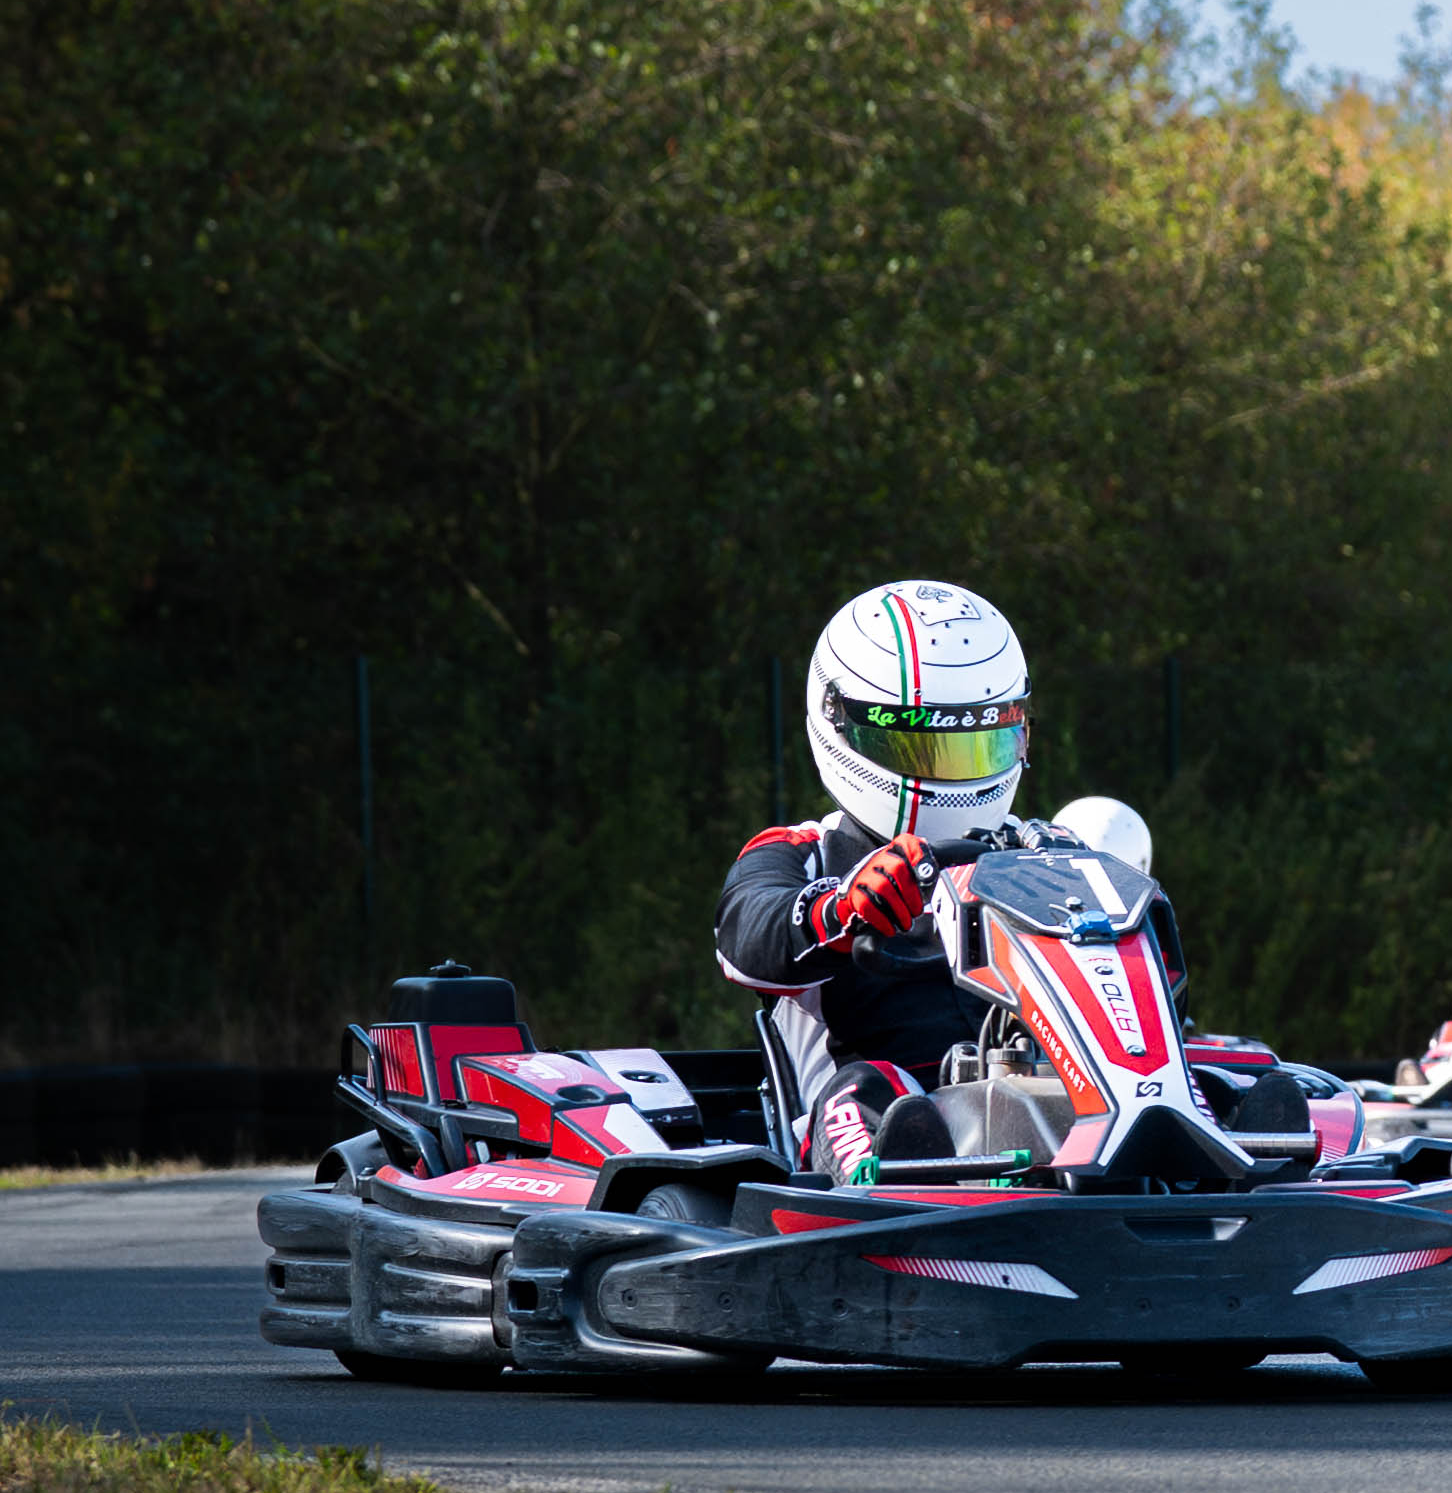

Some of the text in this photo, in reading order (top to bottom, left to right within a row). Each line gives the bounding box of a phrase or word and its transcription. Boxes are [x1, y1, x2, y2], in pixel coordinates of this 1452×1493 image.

[867, 706, 896, 726] La
[901, 707, 958, 727] Vita
[961, 712, 976, 726] è
[1069, 858, 1128, 914] 1
[1031, 1010, 1085, 1093] RACING KART
[486, 1176, 565, 1198] SODI
